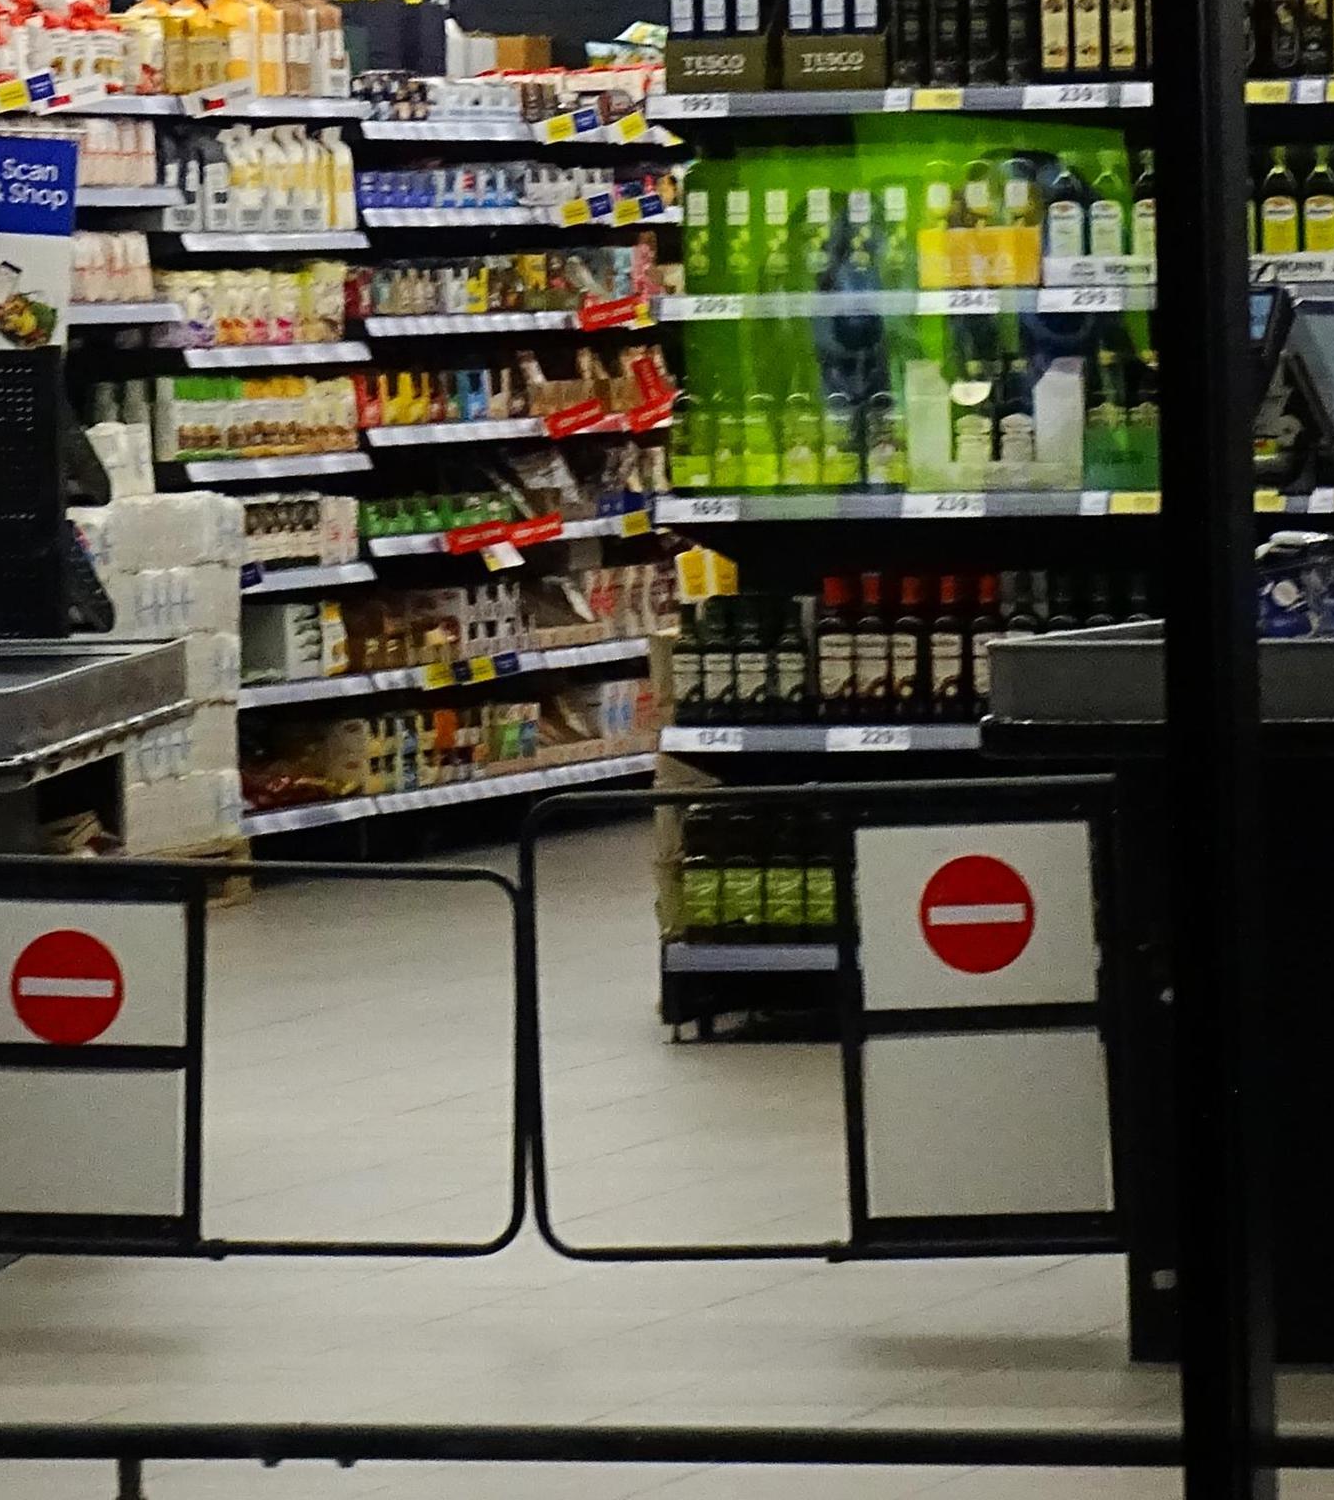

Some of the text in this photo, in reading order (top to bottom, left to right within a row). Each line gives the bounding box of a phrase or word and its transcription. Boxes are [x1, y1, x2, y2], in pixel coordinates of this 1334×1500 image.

[682, 50, 865, 71] TESCO TESCO
[1, 158, 59, 182] Scan
[8, 182, 69, 211] Shop
